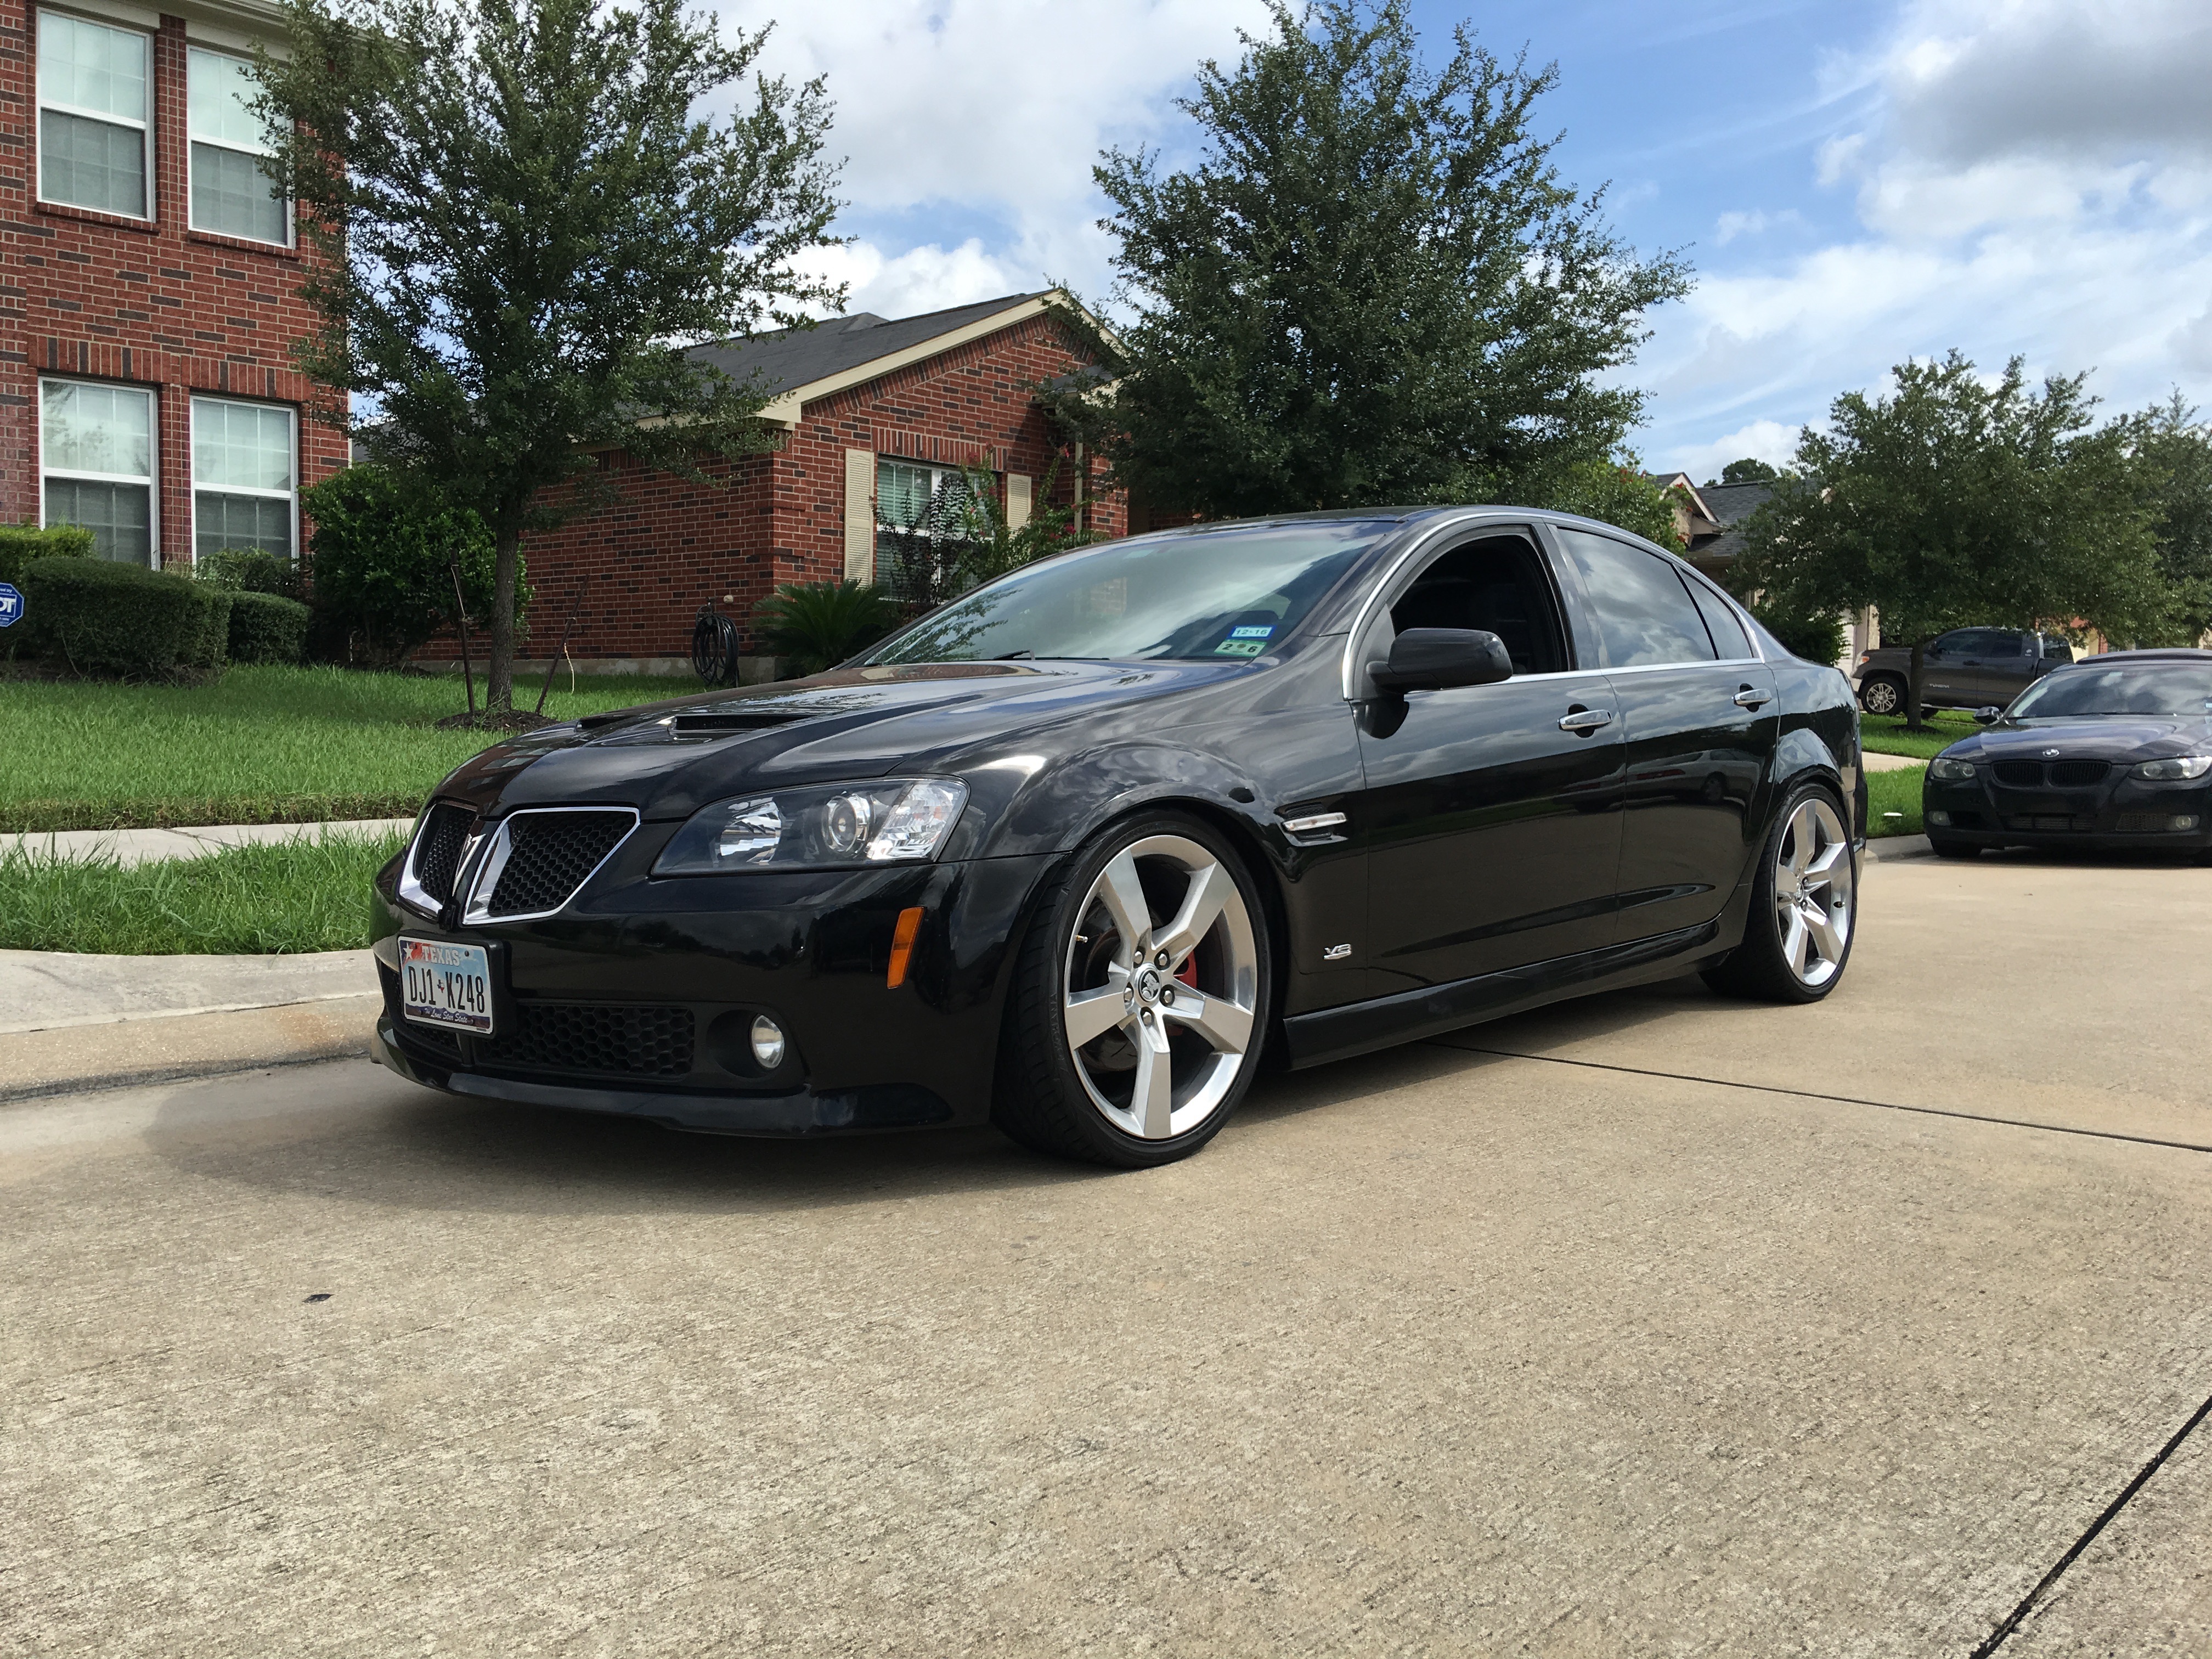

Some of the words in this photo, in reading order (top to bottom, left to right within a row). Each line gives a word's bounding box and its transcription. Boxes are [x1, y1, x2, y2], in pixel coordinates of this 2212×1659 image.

[0, 596, 16, 613] DT
[421, 946, 461, 967] TEXAS
[1324, 944, 1351, 957] V8
[408, 966, 436, 1006] DJ1
[445, 971, 485, 1013] K248
[443, 1011, 454, 1021] Star
[455, 1013, 468, 1023] State
